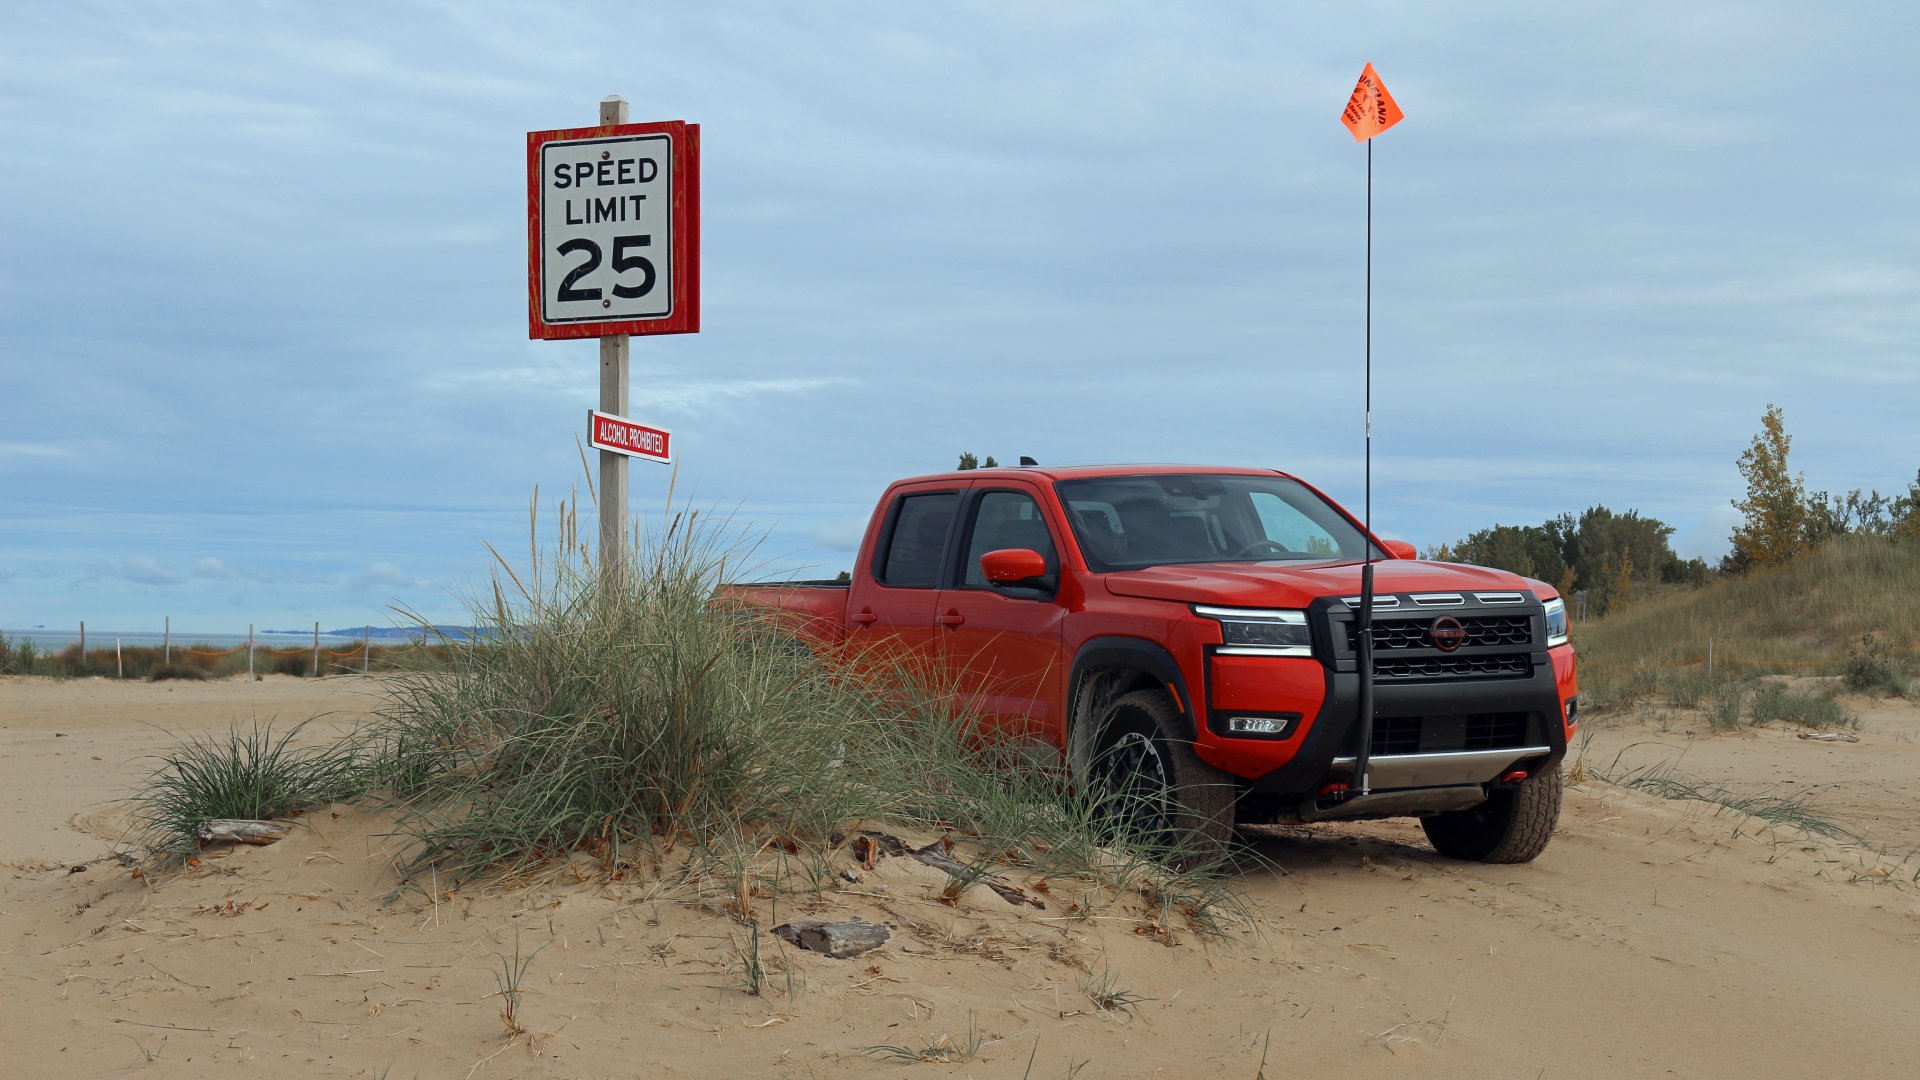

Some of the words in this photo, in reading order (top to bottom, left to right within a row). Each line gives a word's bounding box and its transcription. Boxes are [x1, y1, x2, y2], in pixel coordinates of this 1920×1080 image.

[553, 157, 658, 189] SPEED
[566, 195, 647, 225] LIMIT
[556, 234, 656, 302] 25
[599, 421, 628, 446] ALCOHOL
[629, 427, 664, 454] PROHIBITED
